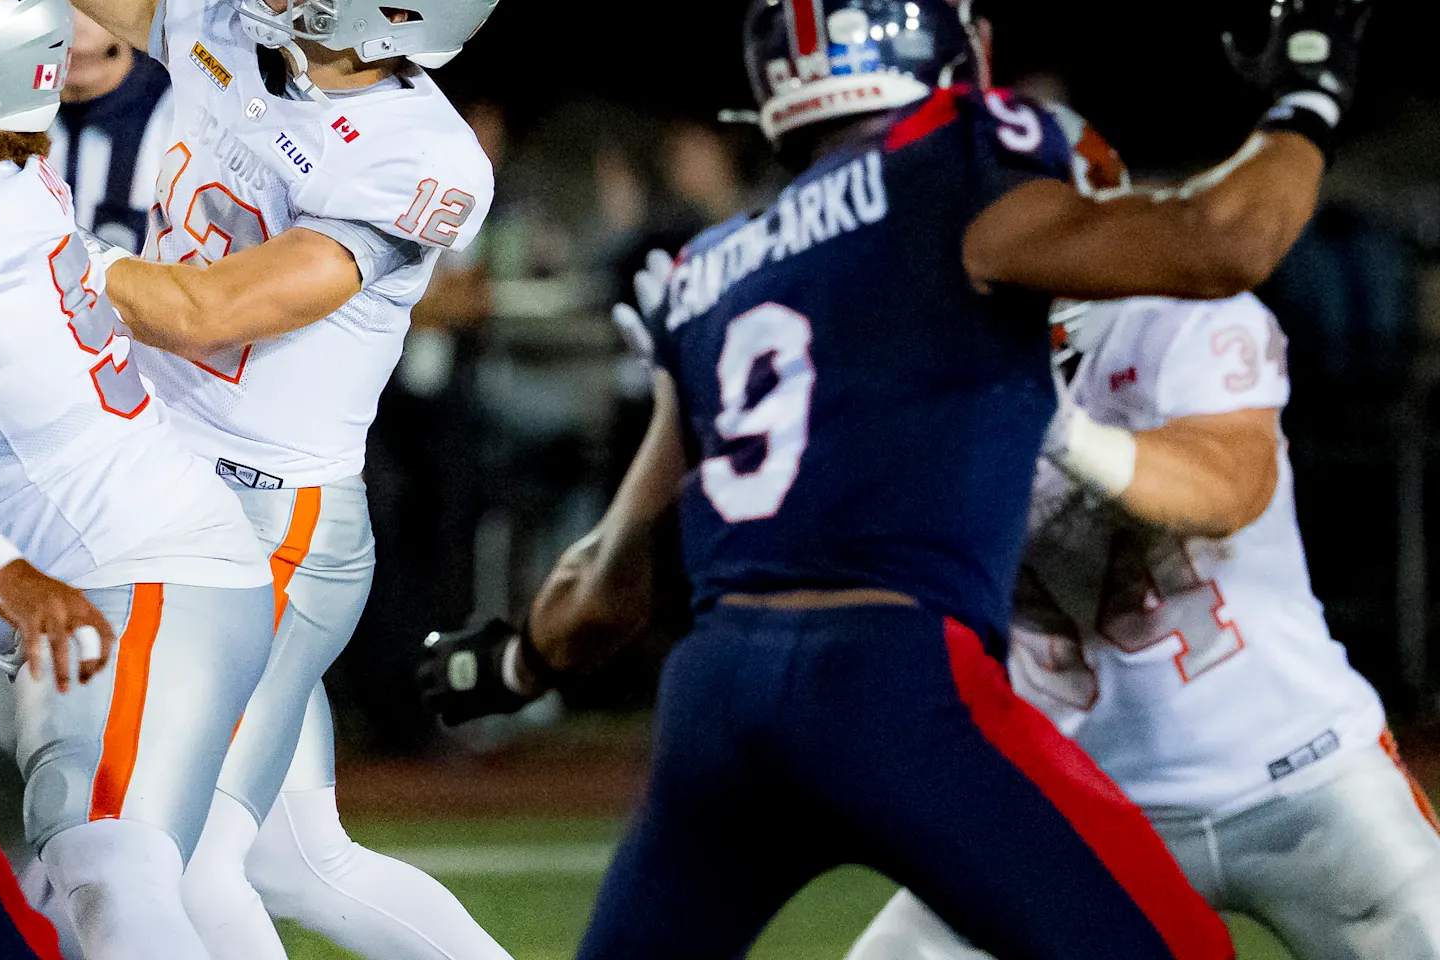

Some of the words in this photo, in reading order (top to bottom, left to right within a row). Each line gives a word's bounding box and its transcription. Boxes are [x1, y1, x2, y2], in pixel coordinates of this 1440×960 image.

[193, 44, 231, 82] LEAVITT
[248, 102, 263, 118] CFL
[275, 132, 313, 175] TELUS
[394, 177, 477, 247] 12
[700, 300, 818, 524] 9
